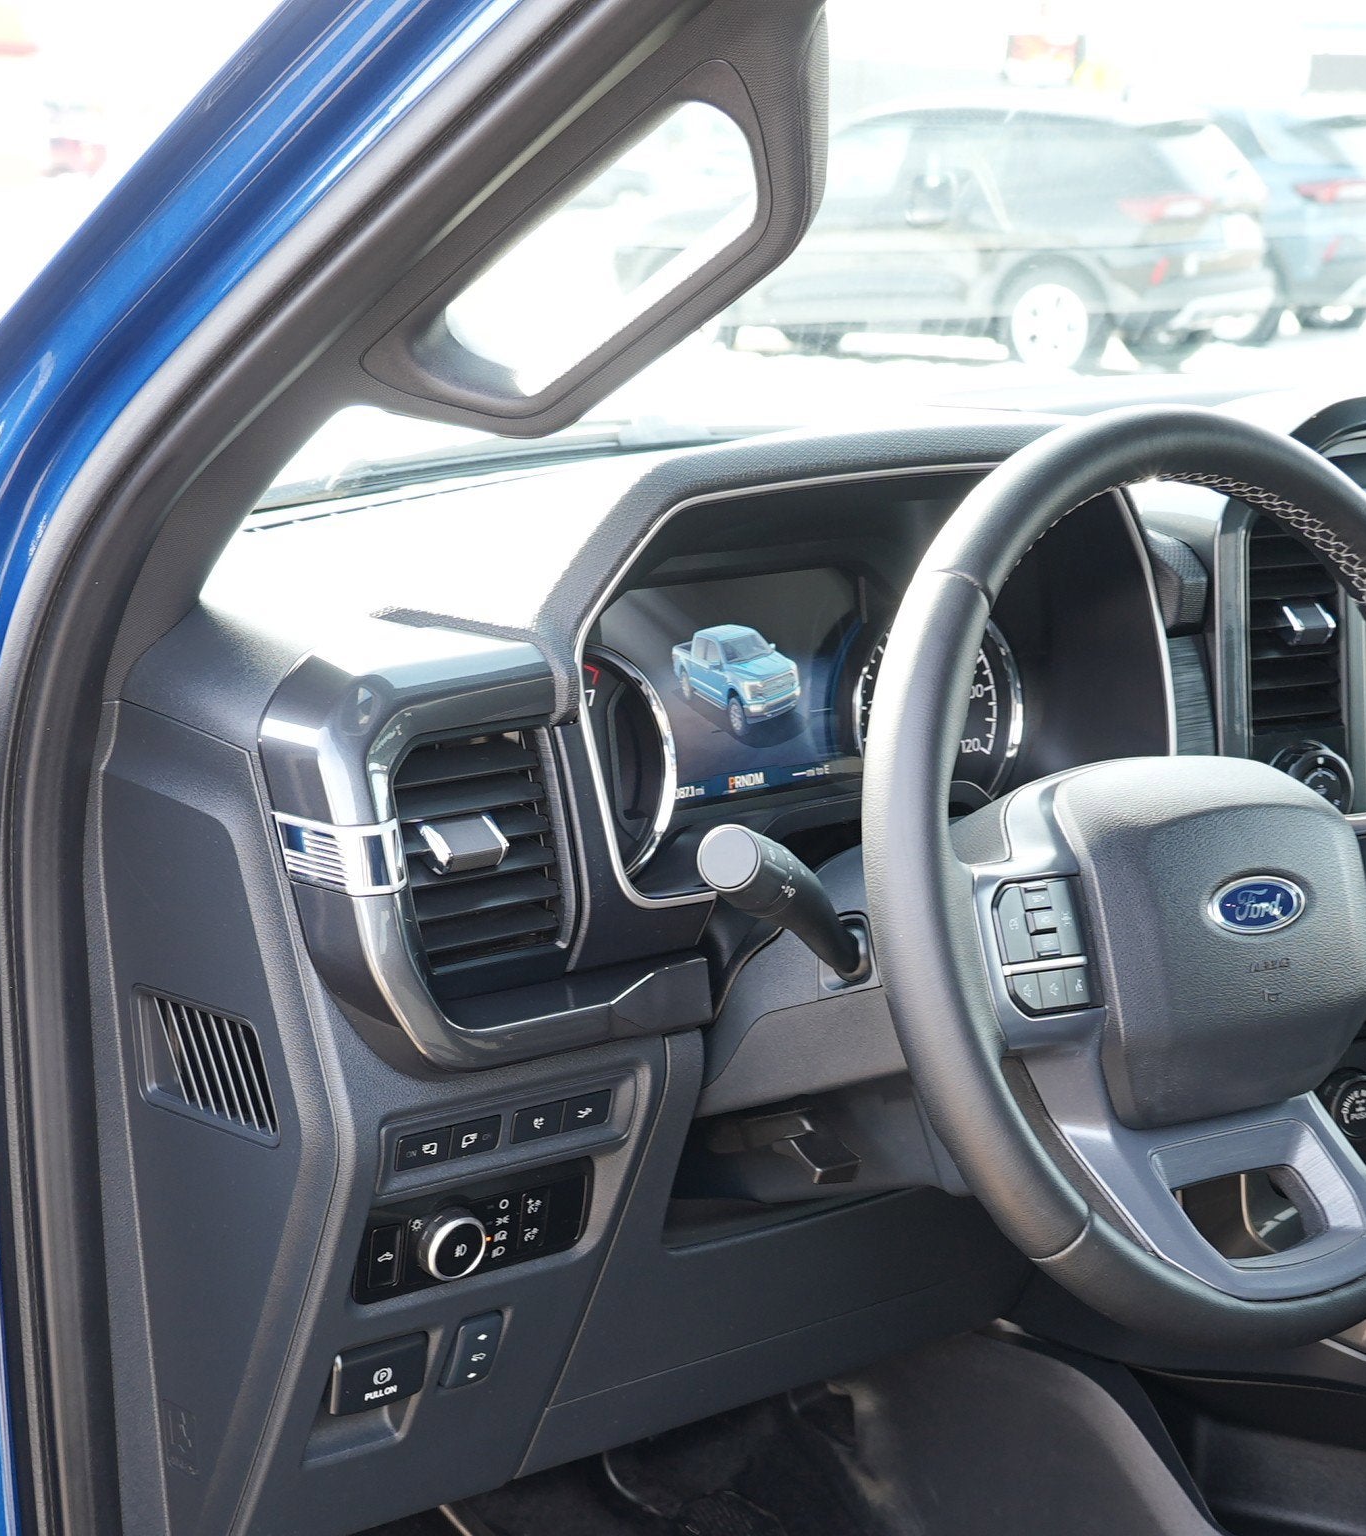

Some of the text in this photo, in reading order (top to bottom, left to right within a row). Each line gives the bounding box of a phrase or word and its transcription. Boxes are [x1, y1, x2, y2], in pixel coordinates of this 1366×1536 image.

[584, 689, 596, 707] 7
[960, 737, 982, 754] 120
[1235, 888, 1286, 921] Ford
[364, 1384, 398, 1402] PULL ON
